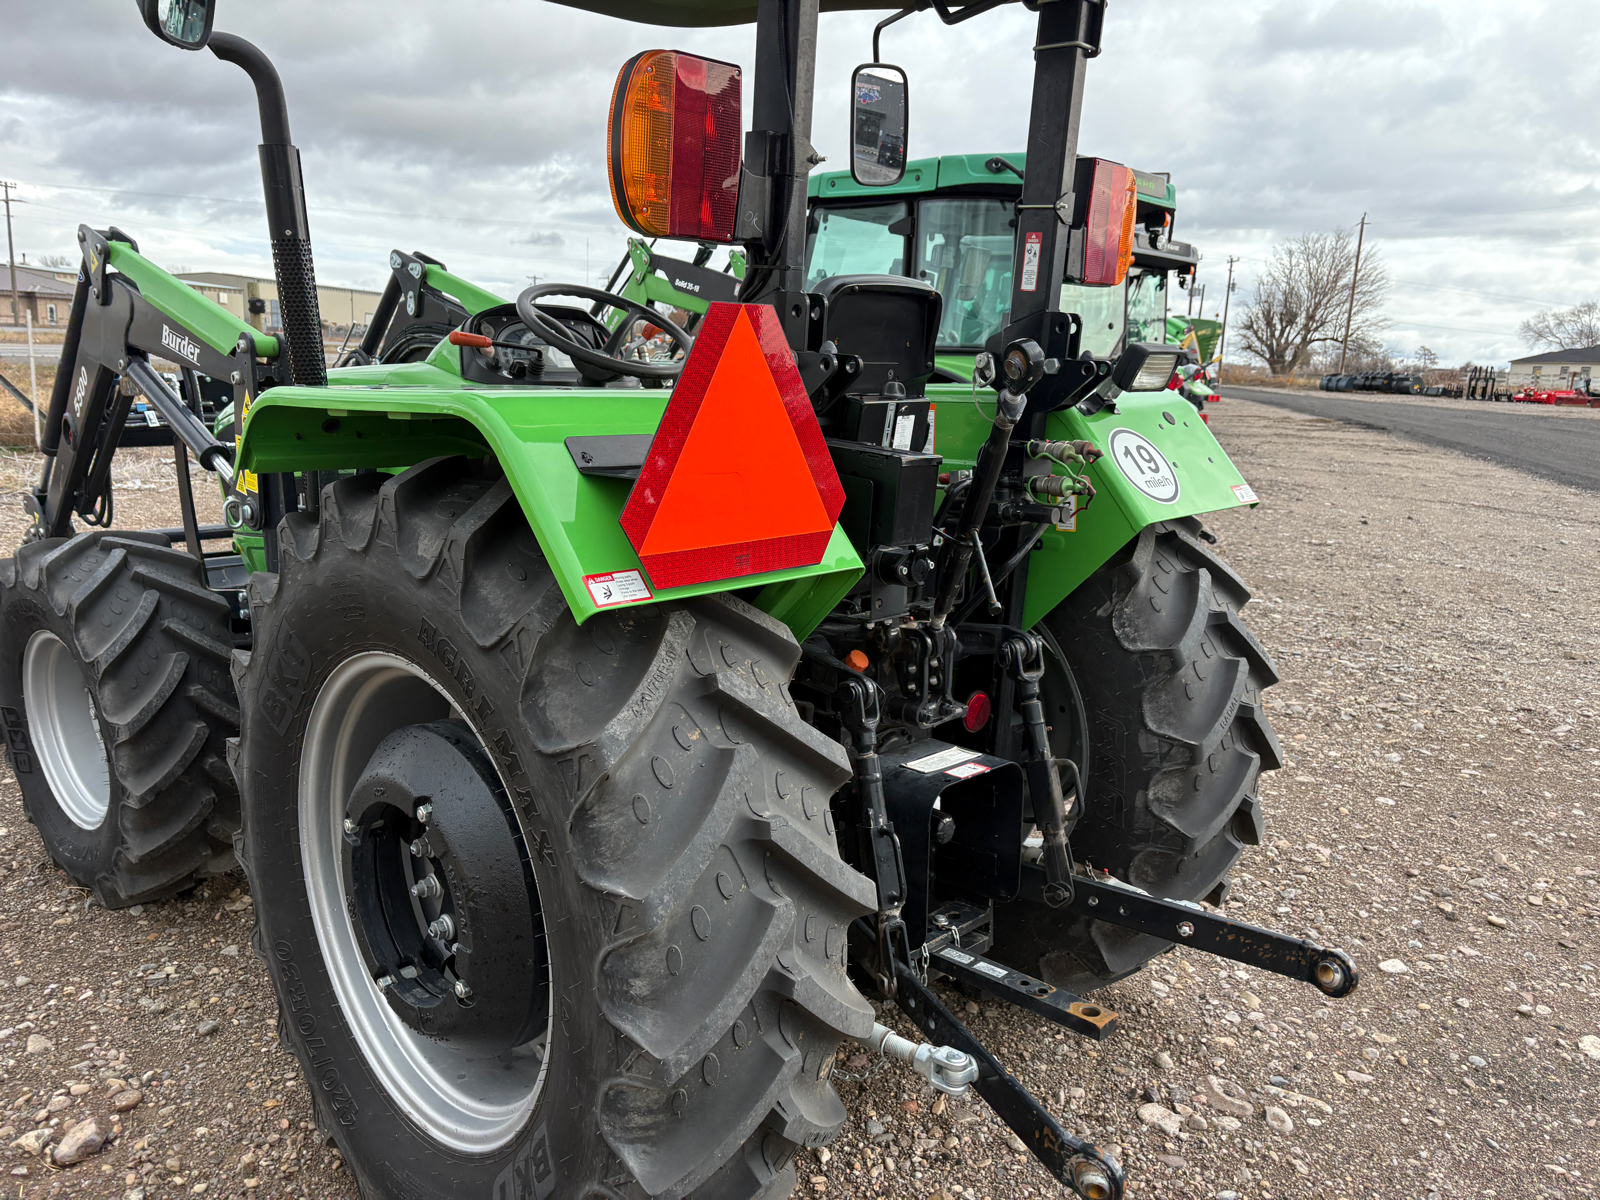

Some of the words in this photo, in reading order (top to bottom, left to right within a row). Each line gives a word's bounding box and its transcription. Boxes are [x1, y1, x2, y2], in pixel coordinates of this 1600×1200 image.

[674, 278, 687, 290] Solid
[161, 323, 201, 362] Burder
[73, 365, 88, 418] 5500
[1123, 444, 1160, 475] 19
[1144, 475, 1174, 489] mile/h
[1219, 696, 1239, 730] RADIAL
[1, 706, 33, 774] BKT
[274, 939, 360, 1126] 420/70R30
